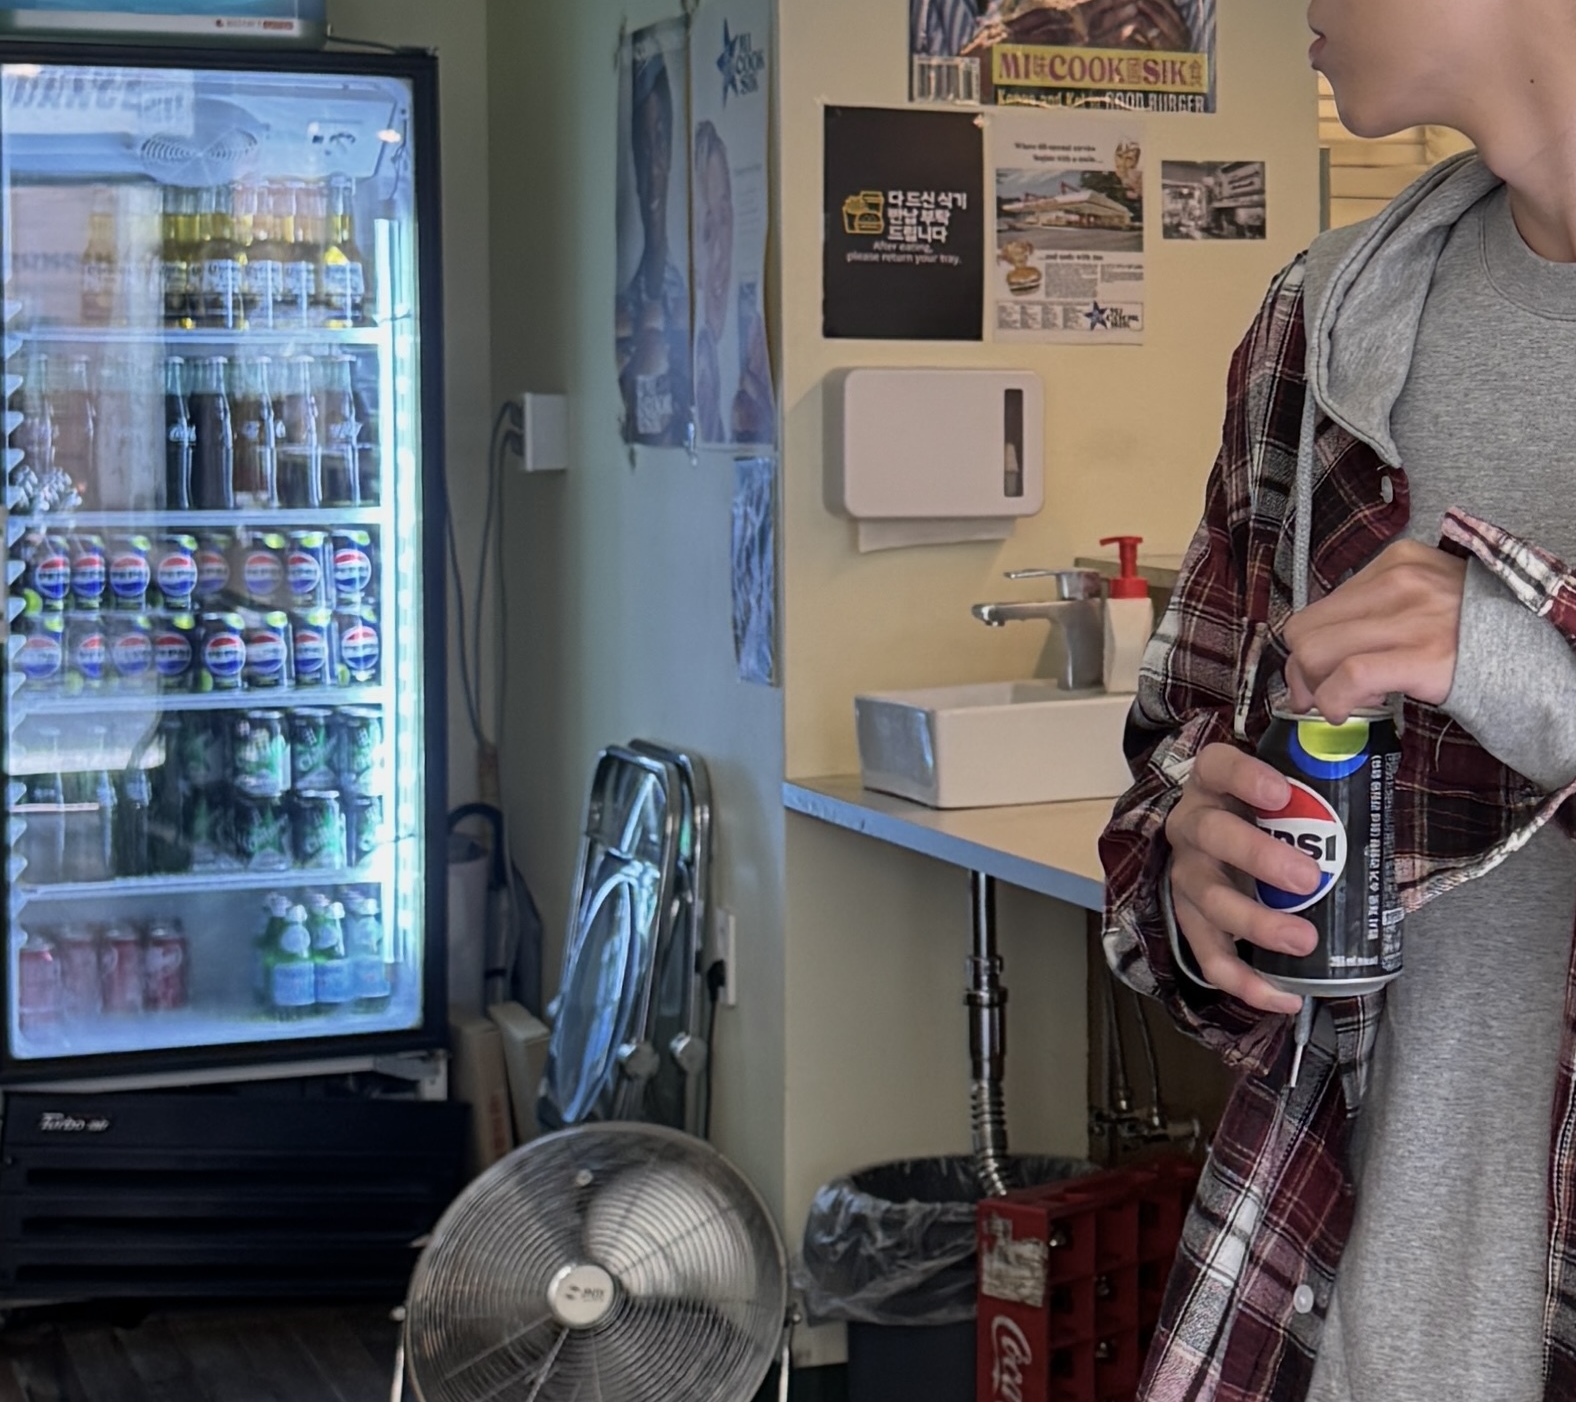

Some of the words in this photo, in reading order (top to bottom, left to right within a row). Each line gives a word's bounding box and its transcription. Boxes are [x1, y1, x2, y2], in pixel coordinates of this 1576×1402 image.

[887, 190, 904, 207] 다
[905, 191, 936, 209] 드신
[938, 191, 967, 210] 식기
[887, 225, 948, 243] 드립니다
